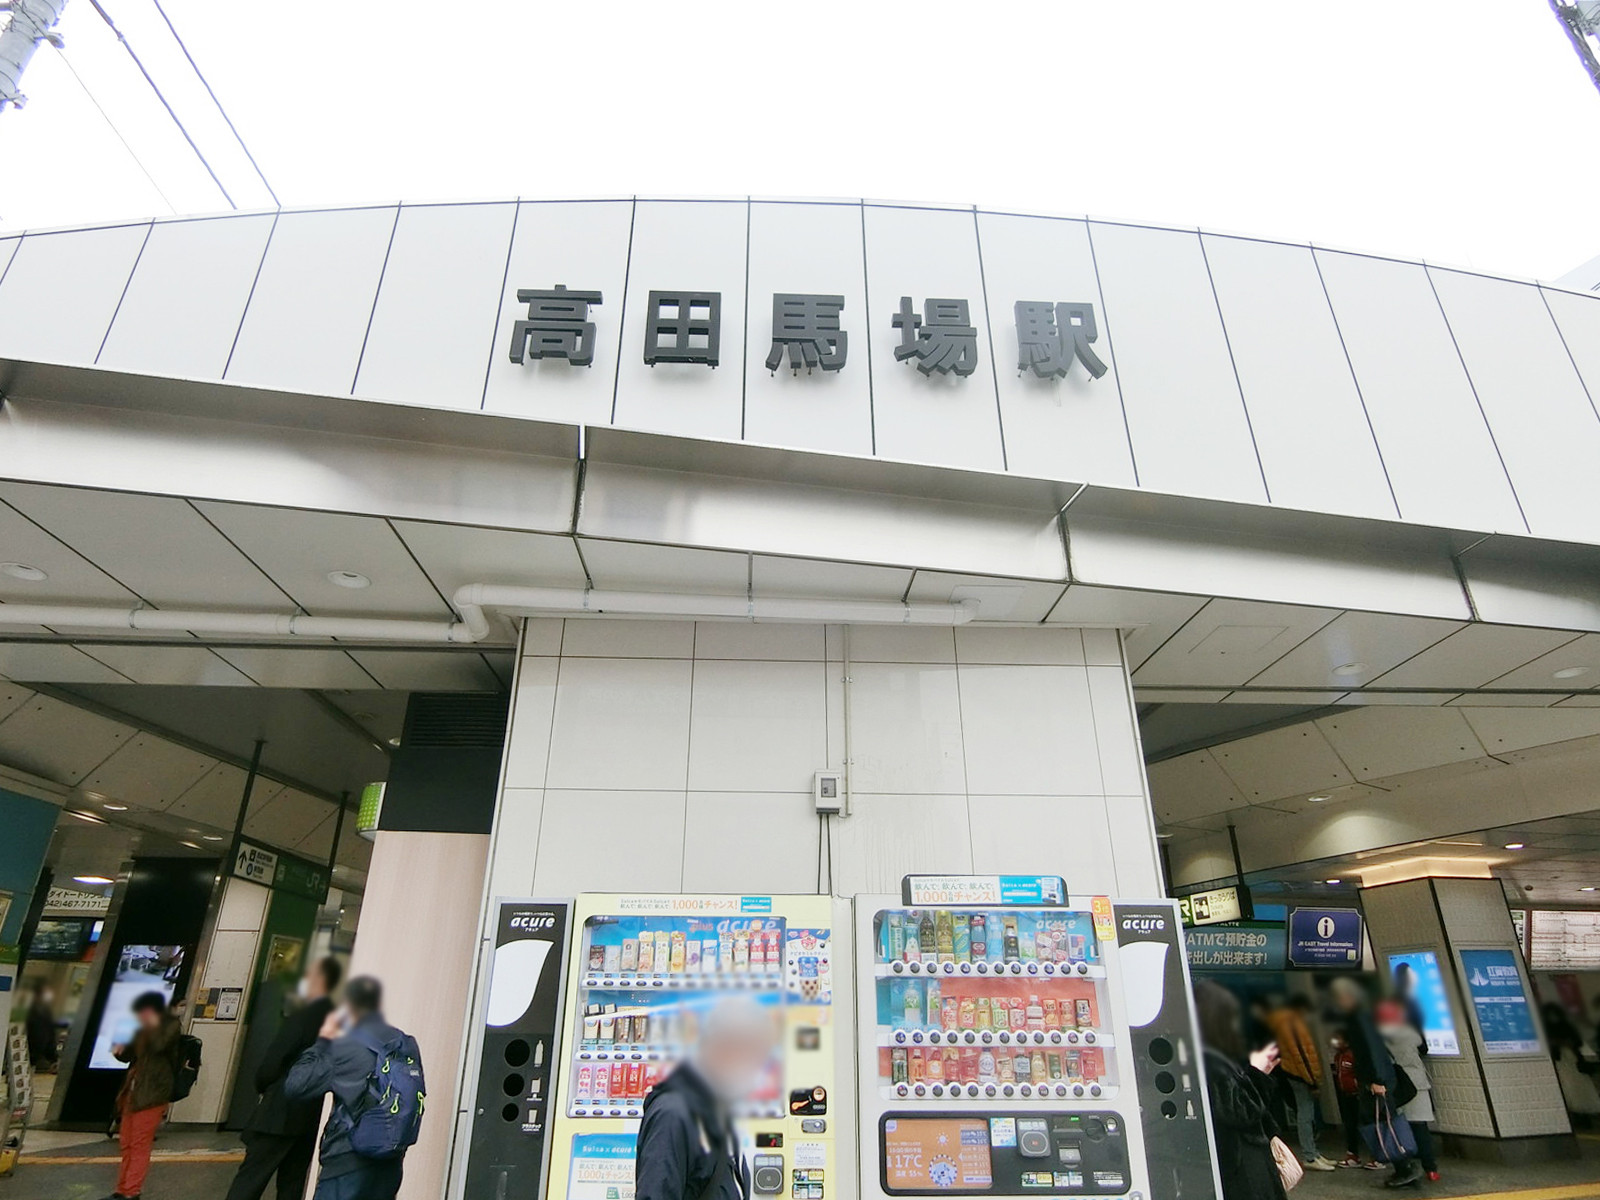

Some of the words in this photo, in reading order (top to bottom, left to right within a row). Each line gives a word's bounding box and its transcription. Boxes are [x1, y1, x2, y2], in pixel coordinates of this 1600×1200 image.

[508, 284, 1108, 381] 高田馬場駅
[510, 916, 556, 928] acure
[1122, 918, 1165, 930] acure
[1183, 932, 1267, 947] ATMで預貯金の
